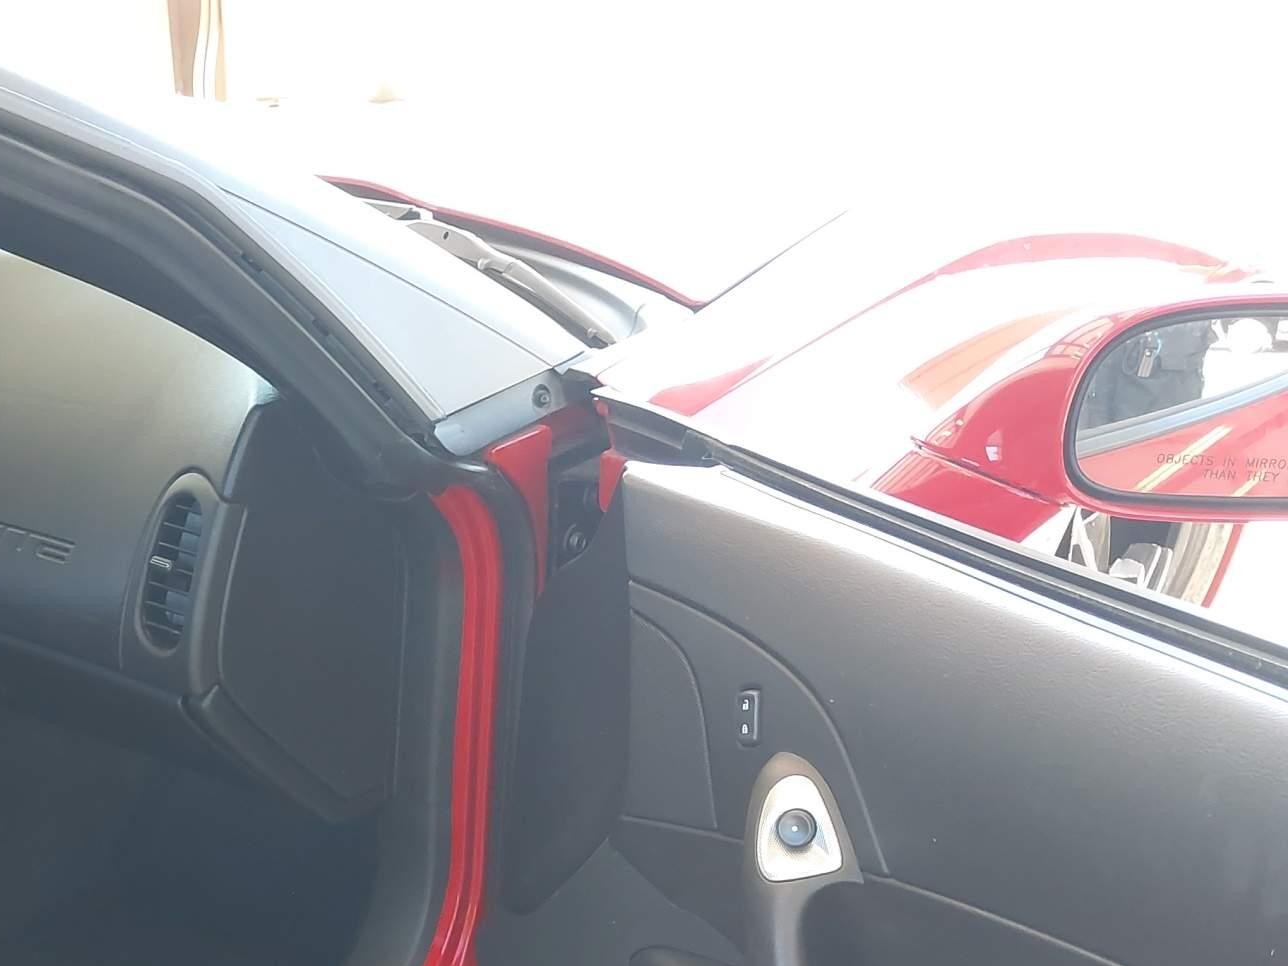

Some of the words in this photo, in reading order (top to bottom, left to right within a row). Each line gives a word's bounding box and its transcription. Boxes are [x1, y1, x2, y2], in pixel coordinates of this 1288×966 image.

[1156, 453, 1214, 466] OBJECTS
[1222, 456, 1235, 466] IN
[1246, 457, 1288, 470] MIRRO
[1203, 468, 1237, 480] THAN
[1247, 470, 1281, 482] THEY
